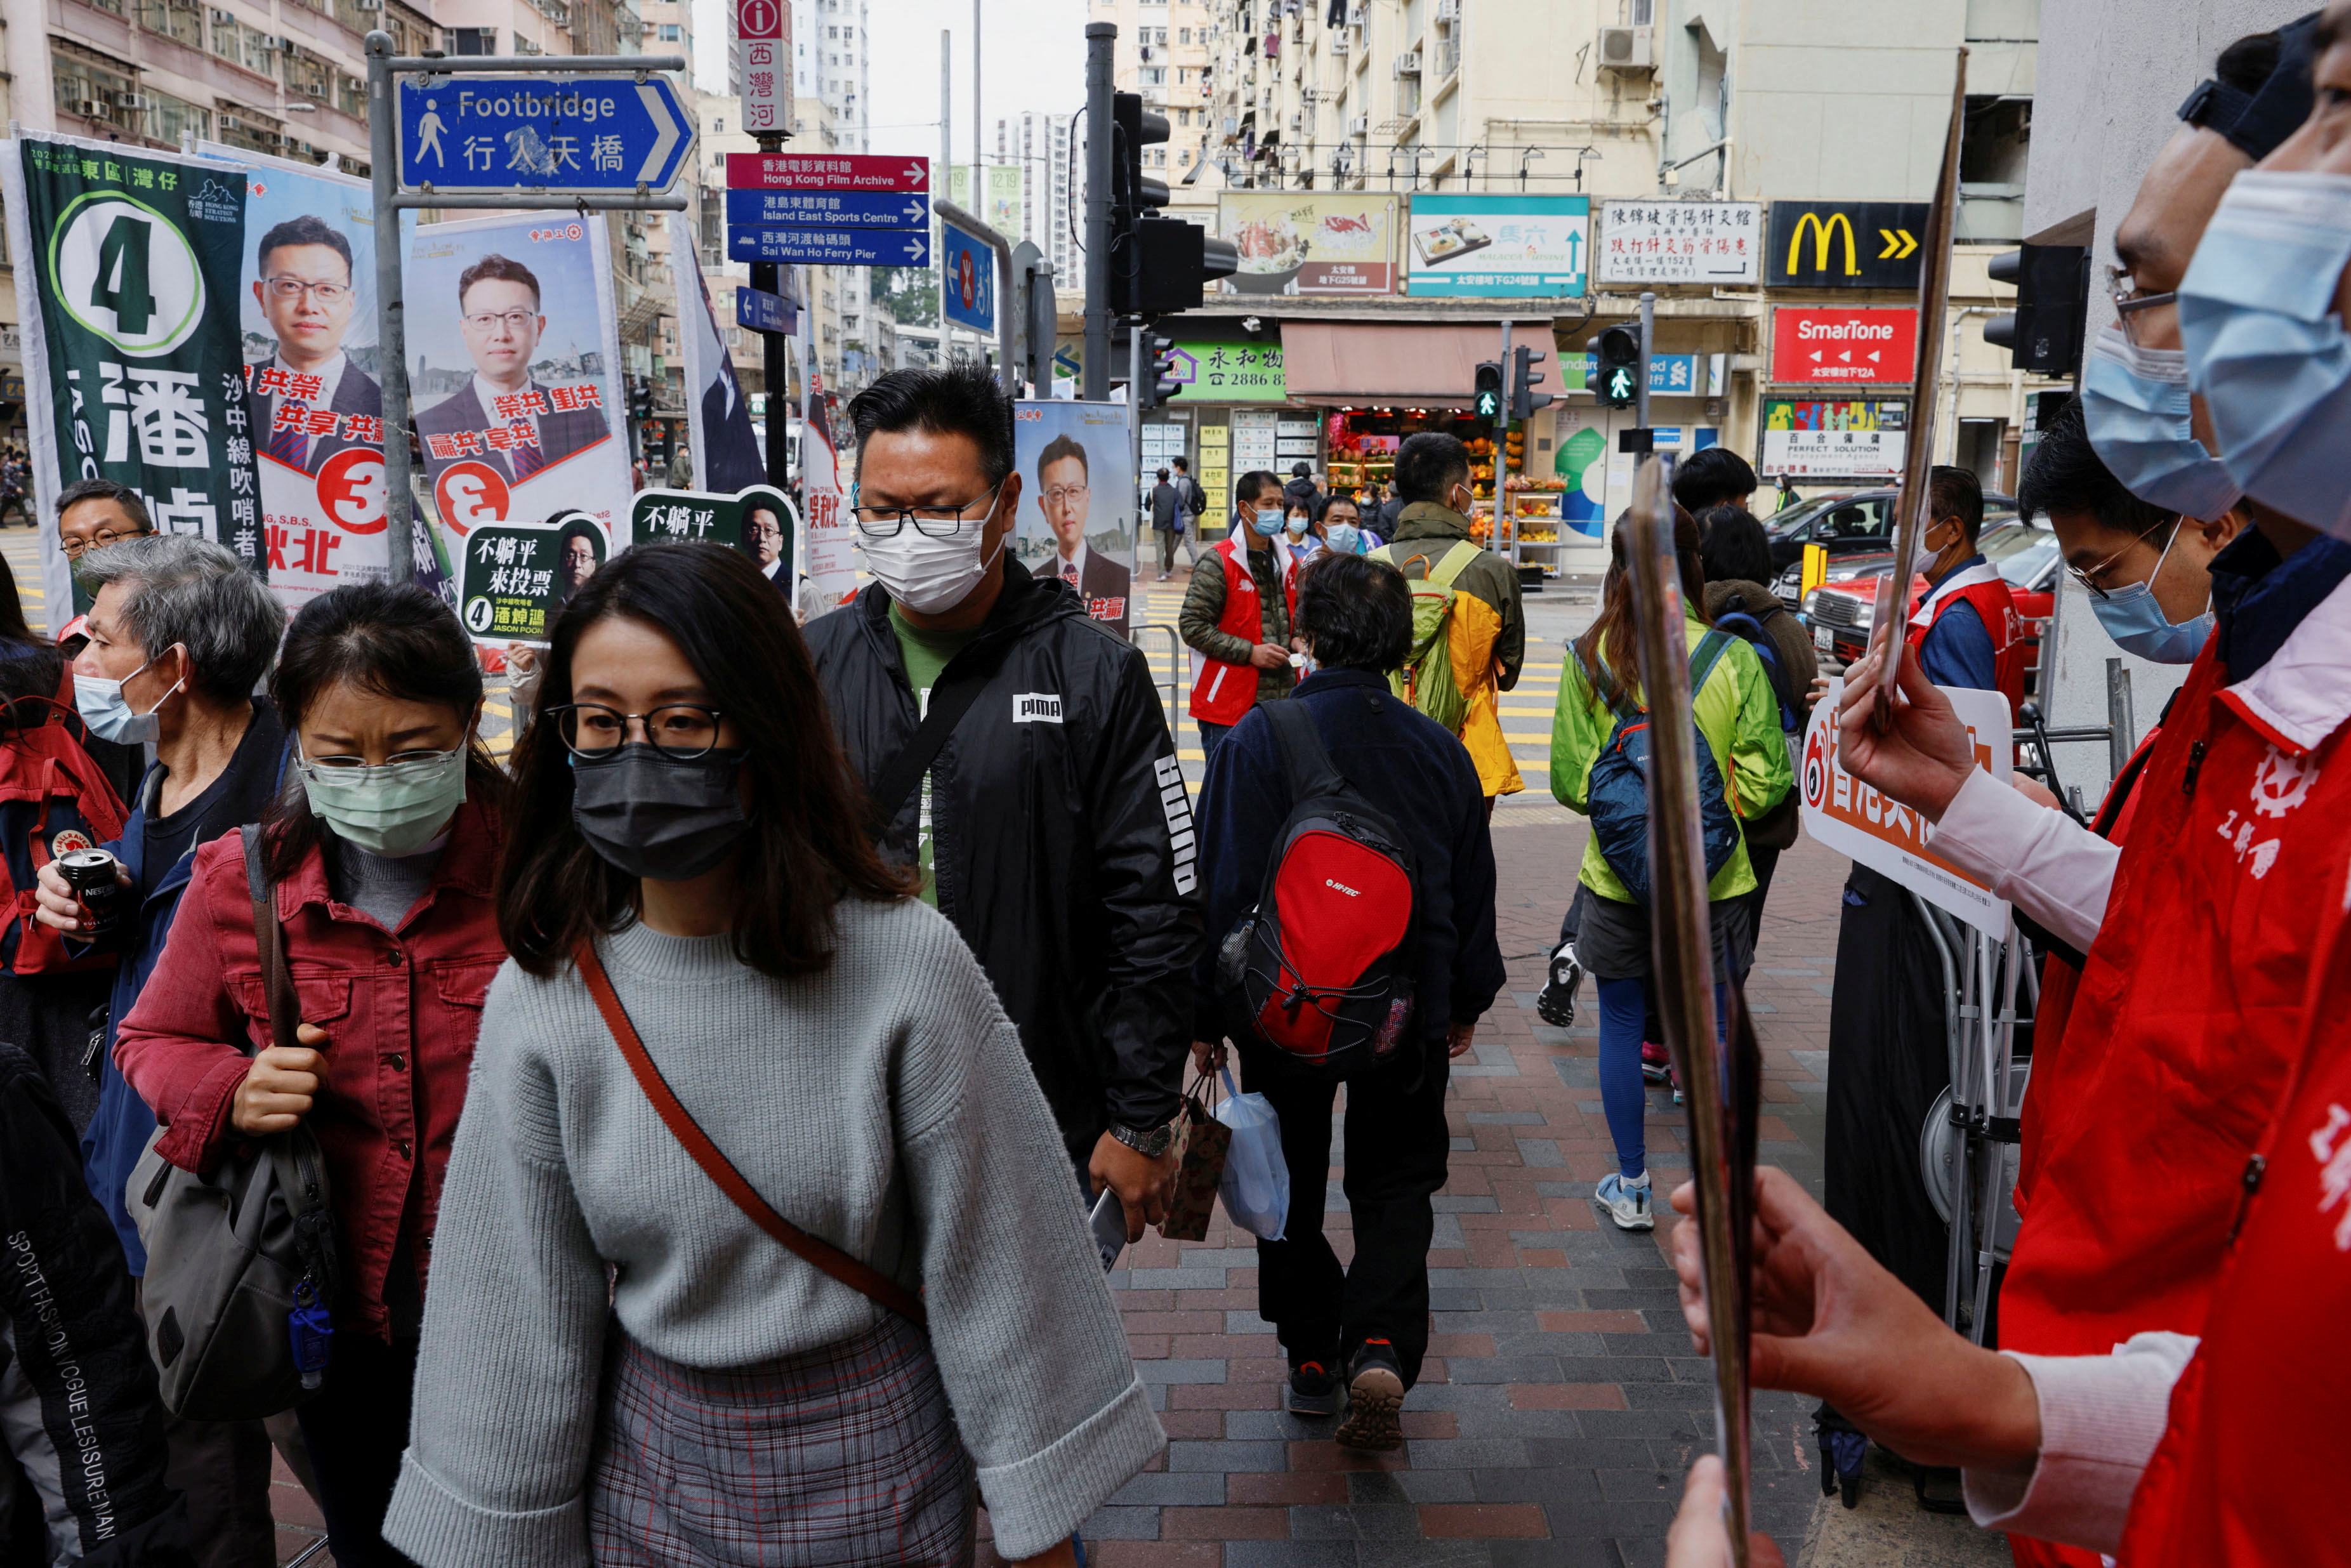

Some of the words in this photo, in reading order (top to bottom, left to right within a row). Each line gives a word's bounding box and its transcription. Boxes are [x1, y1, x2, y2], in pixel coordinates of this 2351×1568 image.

[748, 43, 774, 126] 西灣河
[460, 91, 615, 122] Footbridge
[463, 134, 624, 171] 行人天橋
[763, 160, 852, 173] 香港電影資料館
[764, 175, 792, 185] Hong
[796, 175, 824, 186] Kong
[827, 175, 850, 184] Film
[853, 176, 894, 185] Archive
[205, 202, 222, 210] HONG
[223, 202, 239, 211] KONG
[764, 196, 841, 209] 港島東體育館
[204, 214, 237, 223] SOLUTIONS
[205, 208, 233, 216] STRATEGY
[763, 211, 795, 220] Island
[799, 211, 822, 221] East
[825, 212, 859, 223] Sports
[863, 213, 898, 223] Centre
[762, 232, 851, 246] 西灣河渡輪碼頭
[762, 246, 779, 256] Sai
[781, 247, 804, 256] Wan
[807, 248, 822, 258] Ho
[825, 248, 852, 260] Ferry
[855, 249, 876, 259] Pier
[91, 214, 156, 335] 4
[1798, 320, 1893, 339] SmarTone
[256, 366, 324, 401] 共榮
[1231, 373, 1267, 386] 2886
[273, 404, 339, 438] 共享
[1787, 452, 1843, 461] Employment
[1847, 452, 1879, 461] Agency
[222, 372, 257, 556] 沙中線吹哨者
[279, 515, 312, 527] S.B.S.
[642, 505, 715, 537] 不躺平
[475, 536, 538, 566] 不躺平
[487, 566, 553, 596] 來投票
[471, 602, 485, 627] 4
[493, 624, 519, 633] JASON
[520, 626, 544, 635] POON
[1332, 882, 1359, 897] HI-TEC
